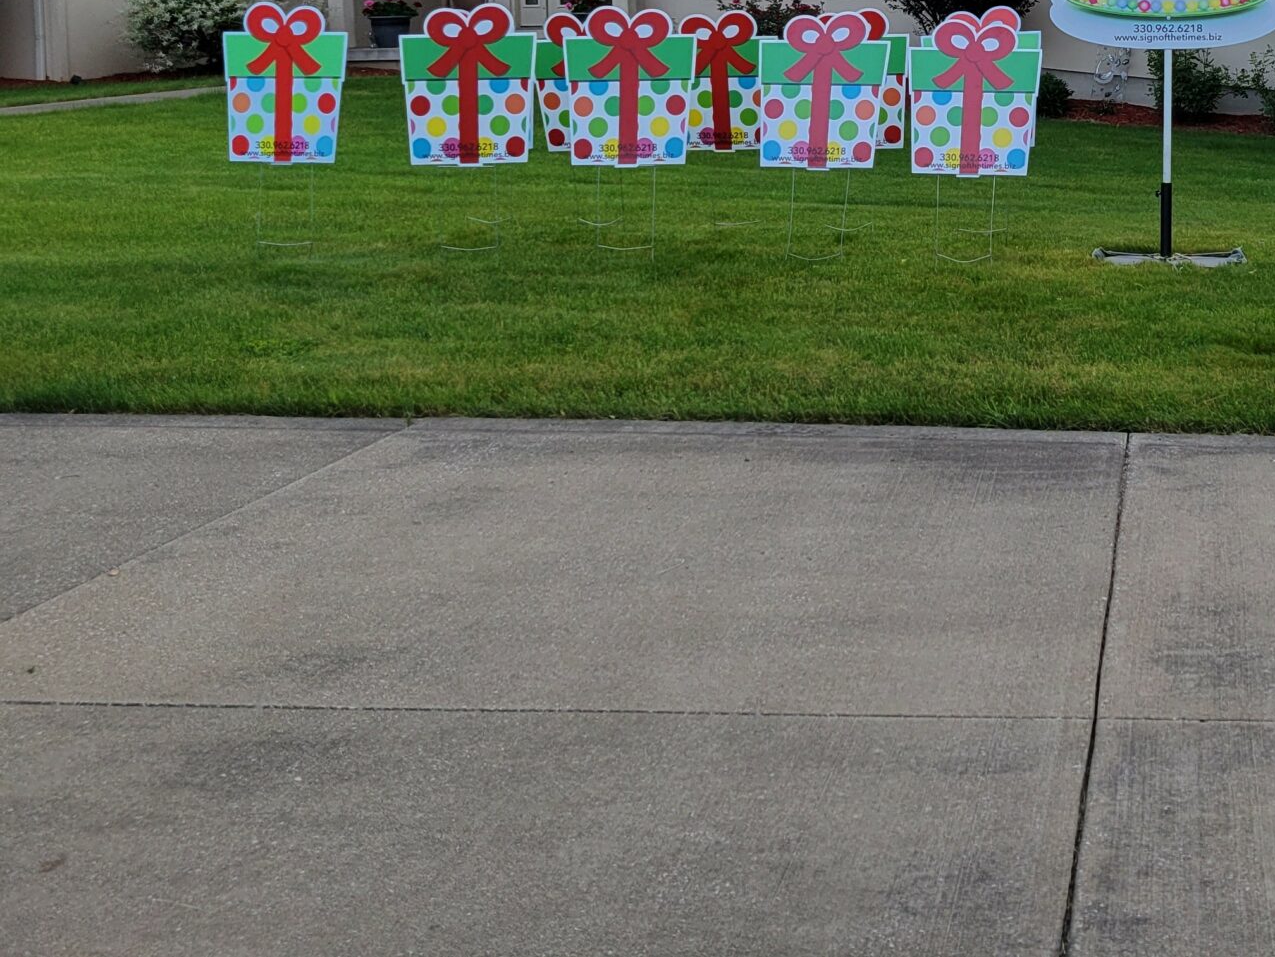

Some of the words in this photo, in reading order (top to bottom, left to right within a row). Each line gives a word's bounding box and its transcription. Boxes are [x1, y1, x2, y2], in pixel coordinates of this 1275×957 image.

[1133, 24, 1203, 33] 330.962.6218
[1114, 33, 1222, 43] www.signofthetimes.biz
[696, 131, 748, 140] 330.92.6218
[438, 142, 499, 152] 330.92.6218
[598, 143, 657, 152] 330.92.6218
[787, 146, 846, 155] 330.962.6218
[771, 154, 863, 164] www.signetimes.bz
[939, 153, 999, 162] 330.962.6218
[929, 161, 1017, 171] ww.signofthetimes.biz
